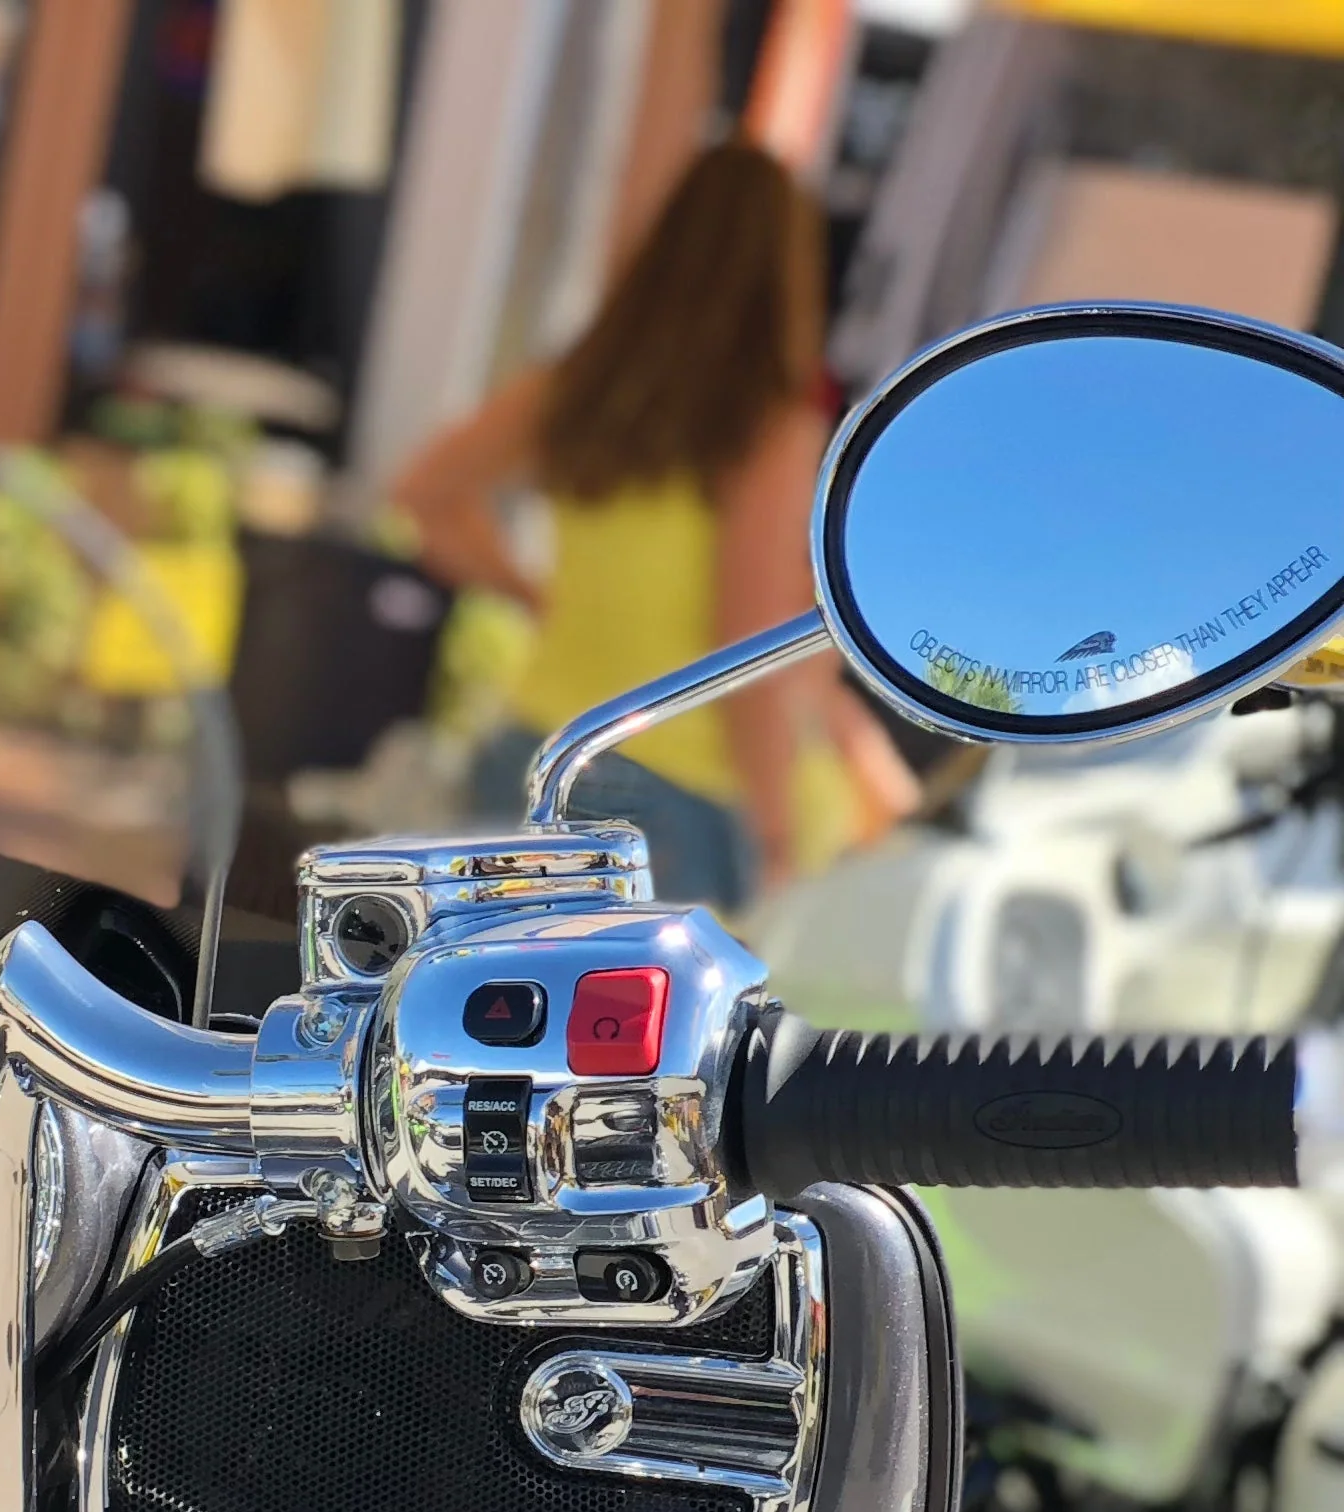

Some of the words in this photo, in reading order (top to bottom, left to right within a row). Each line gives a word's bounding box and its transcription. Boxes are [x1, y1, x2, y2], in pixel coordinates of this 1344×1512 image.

[909, 628, 981, 683] OBJECTS
[1001, 667, 1070, 694] MIRROR
[1075, 663, 1111, 692] ARE
[1110, 641, 1179, 683] CLOSER
[1174, 616, 1227, 655] THAN
[1220, 588, 1269, 630] THEY
[1265, 545, 1330, 604] APPEAR
[468, 1100, 517, 1112] RES/ACC
[469, 1176, 518, 1188] SET/DEC
